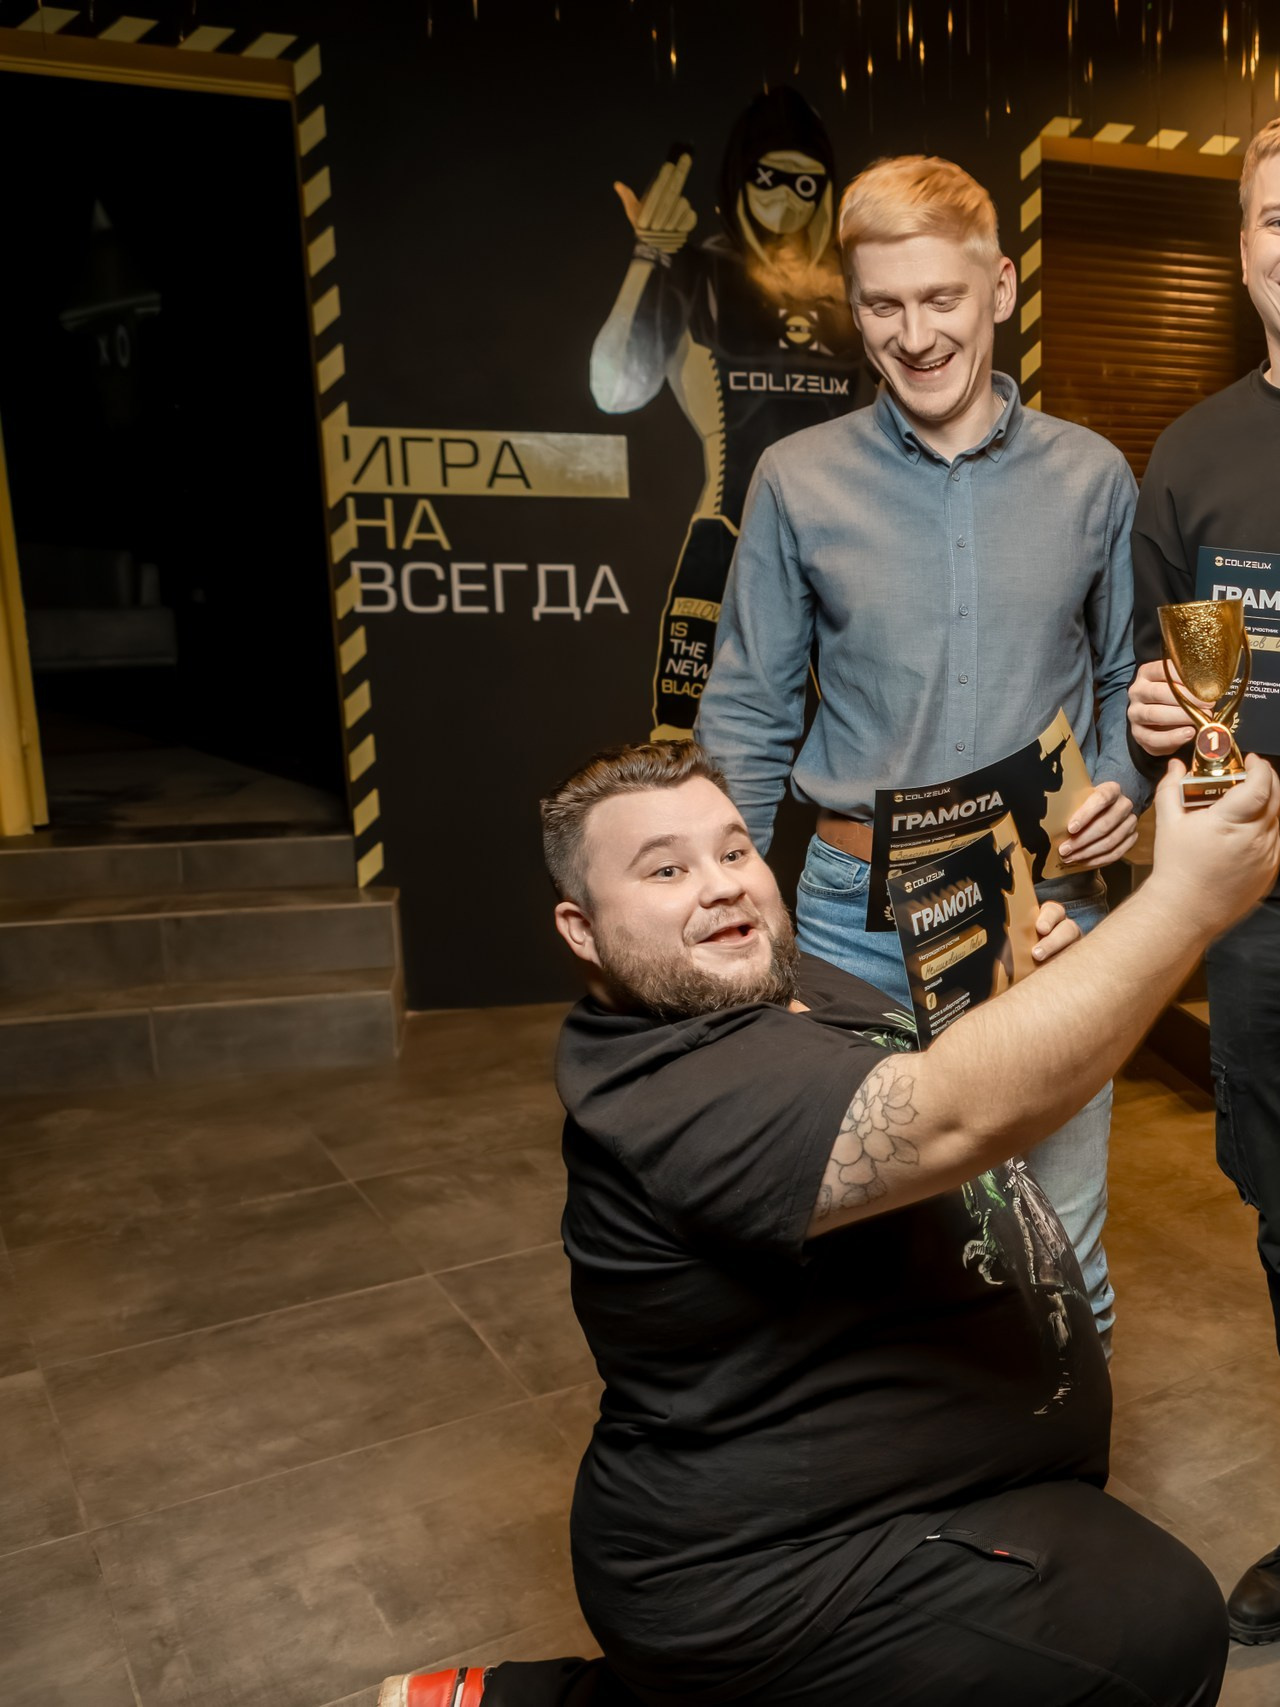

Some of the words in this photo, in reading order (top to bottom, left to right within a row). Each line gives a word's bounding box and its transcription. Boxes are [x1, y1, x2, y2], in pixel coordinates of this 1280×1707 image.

[729, 370, 849, 395] COLIZEUM
[342, 434, 533, 490] ИГРА
[346, 497, 452, 551] НА
[1224, 557, 1273, 570] COLIZEUM
[351, 561, 630, 622] ВСЕГДА
[669, 621, 689, 638] IS
[669, 638, 708, 660] THE
[1206, 731, 1220, 751] 1
[905, 787, 951, 801] COLIZEUM
[892, 790, 1004, 832] ГРАМОТА
[912, 869, 945, 889] COLIZEUM
[911, 882, 983, 936] ГРАМОТА
